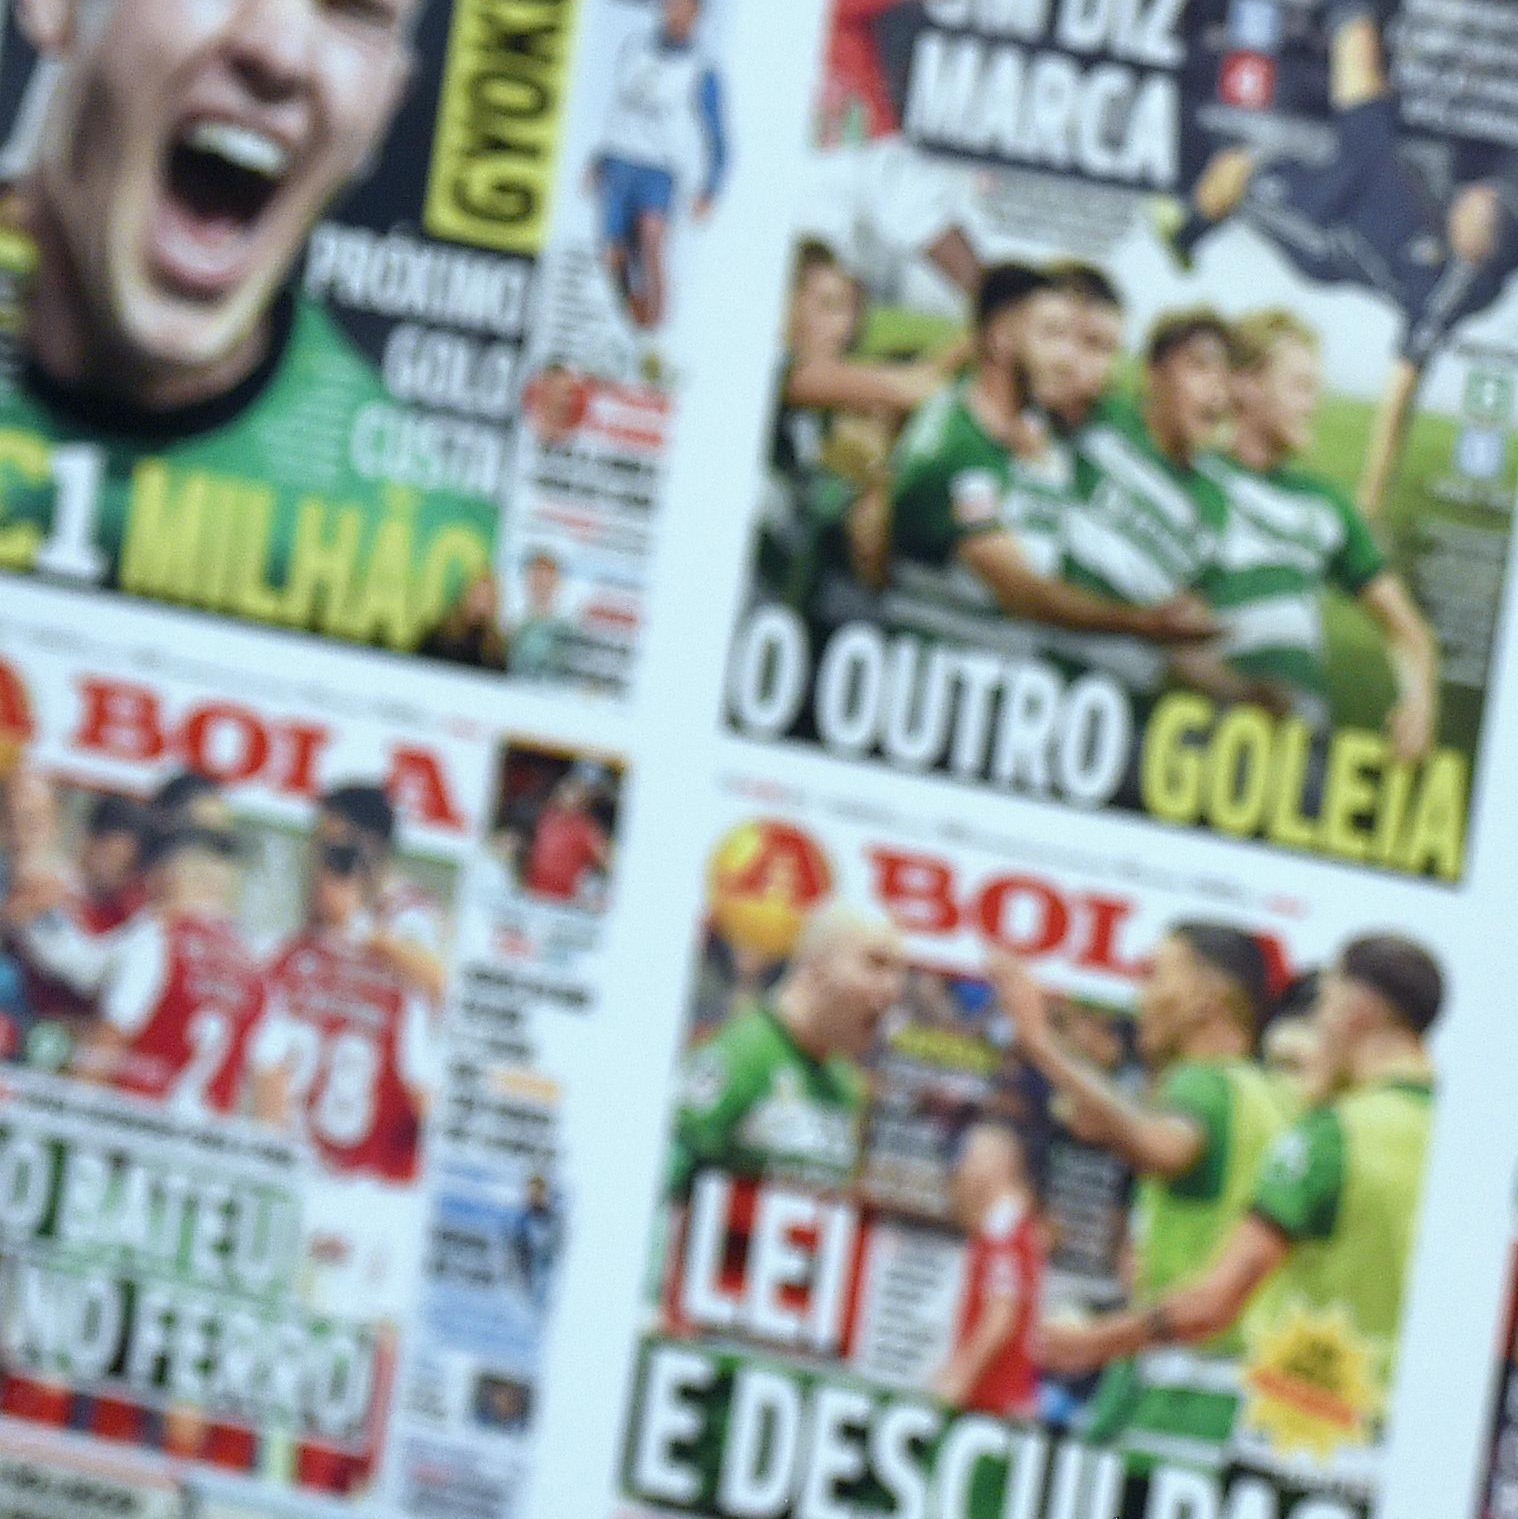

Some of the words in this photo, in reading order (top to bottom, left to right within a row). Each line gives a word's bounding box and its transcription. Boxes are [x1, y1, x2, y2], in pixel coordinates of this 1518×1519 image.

[906, 34, 1181, 187] MARCA
[309, 225, 533, 332] PRÓXIMO
[383, 323, 520, 418] GOLO
[352, 404, 502, 500] CUSTA
[122, 459, 489, 652] MILHÃO
[72, 675, 465, 832] BOLA
[734, 603, 811, 737] O
[816, 622, 1135, 810] OUTRO
[1142, 692, 1470, 883] GOLEIA
[718, 821, 833, 904] A
[679, 1176, 859, 1357] LEI
[628, 1348, 718, 1505] E
[715, 1362, 1365, 1519] DESCUL
